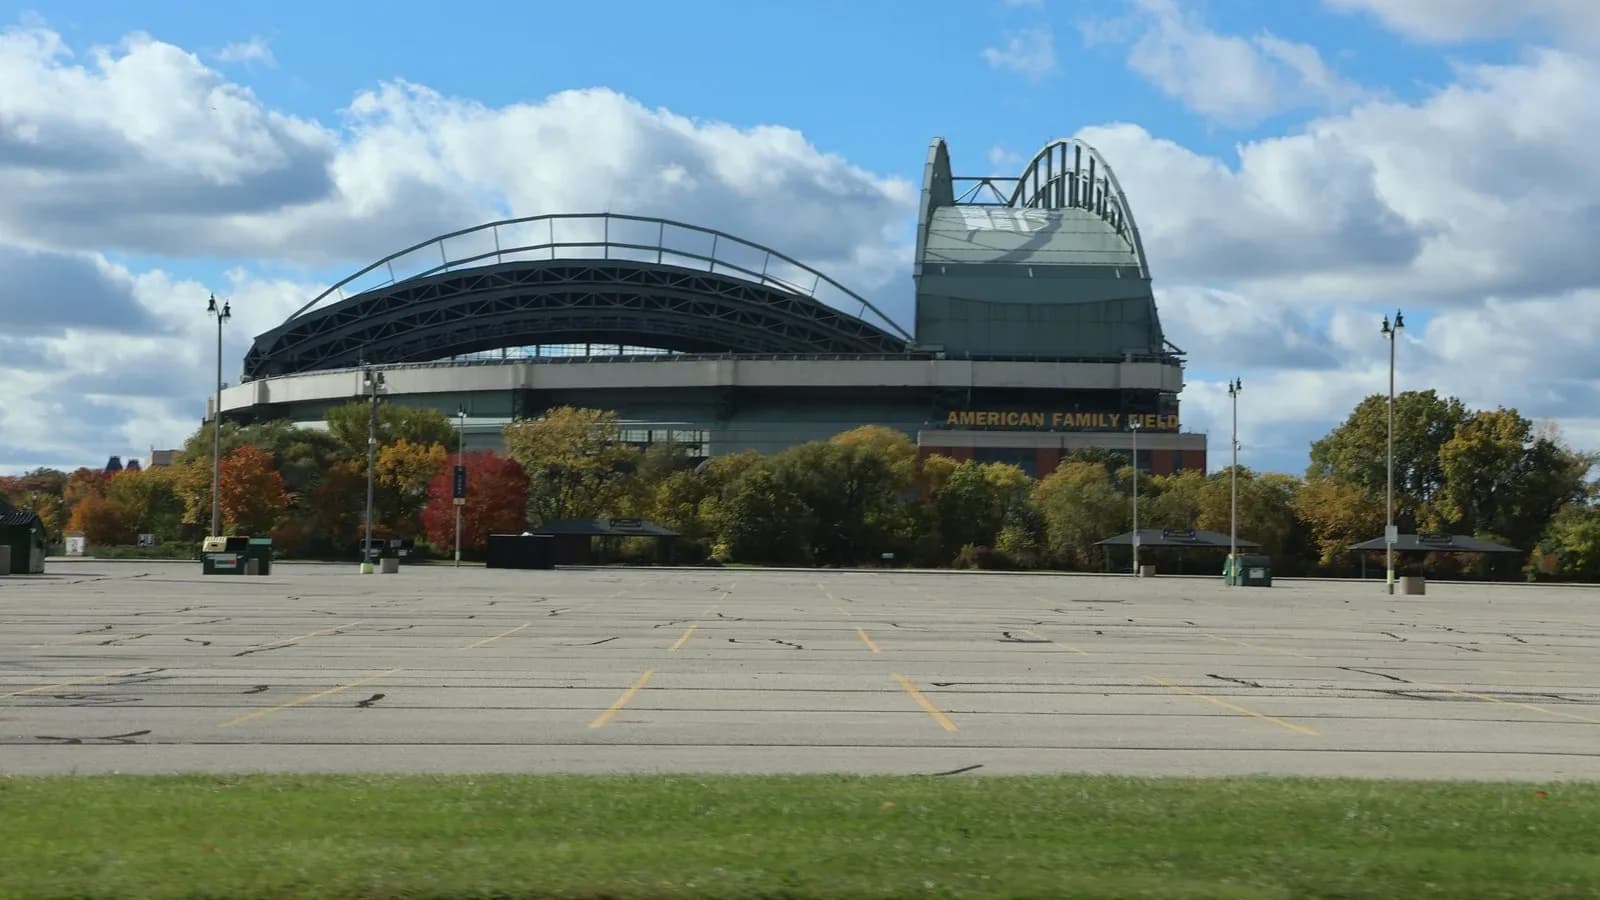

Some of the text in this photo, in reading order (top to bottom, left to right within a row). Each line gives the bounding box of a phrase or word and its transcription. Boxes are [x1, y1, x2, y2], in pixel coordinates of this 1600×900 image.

[946, 411, 1178, 429] AMERICAN FAMILY FIELD
